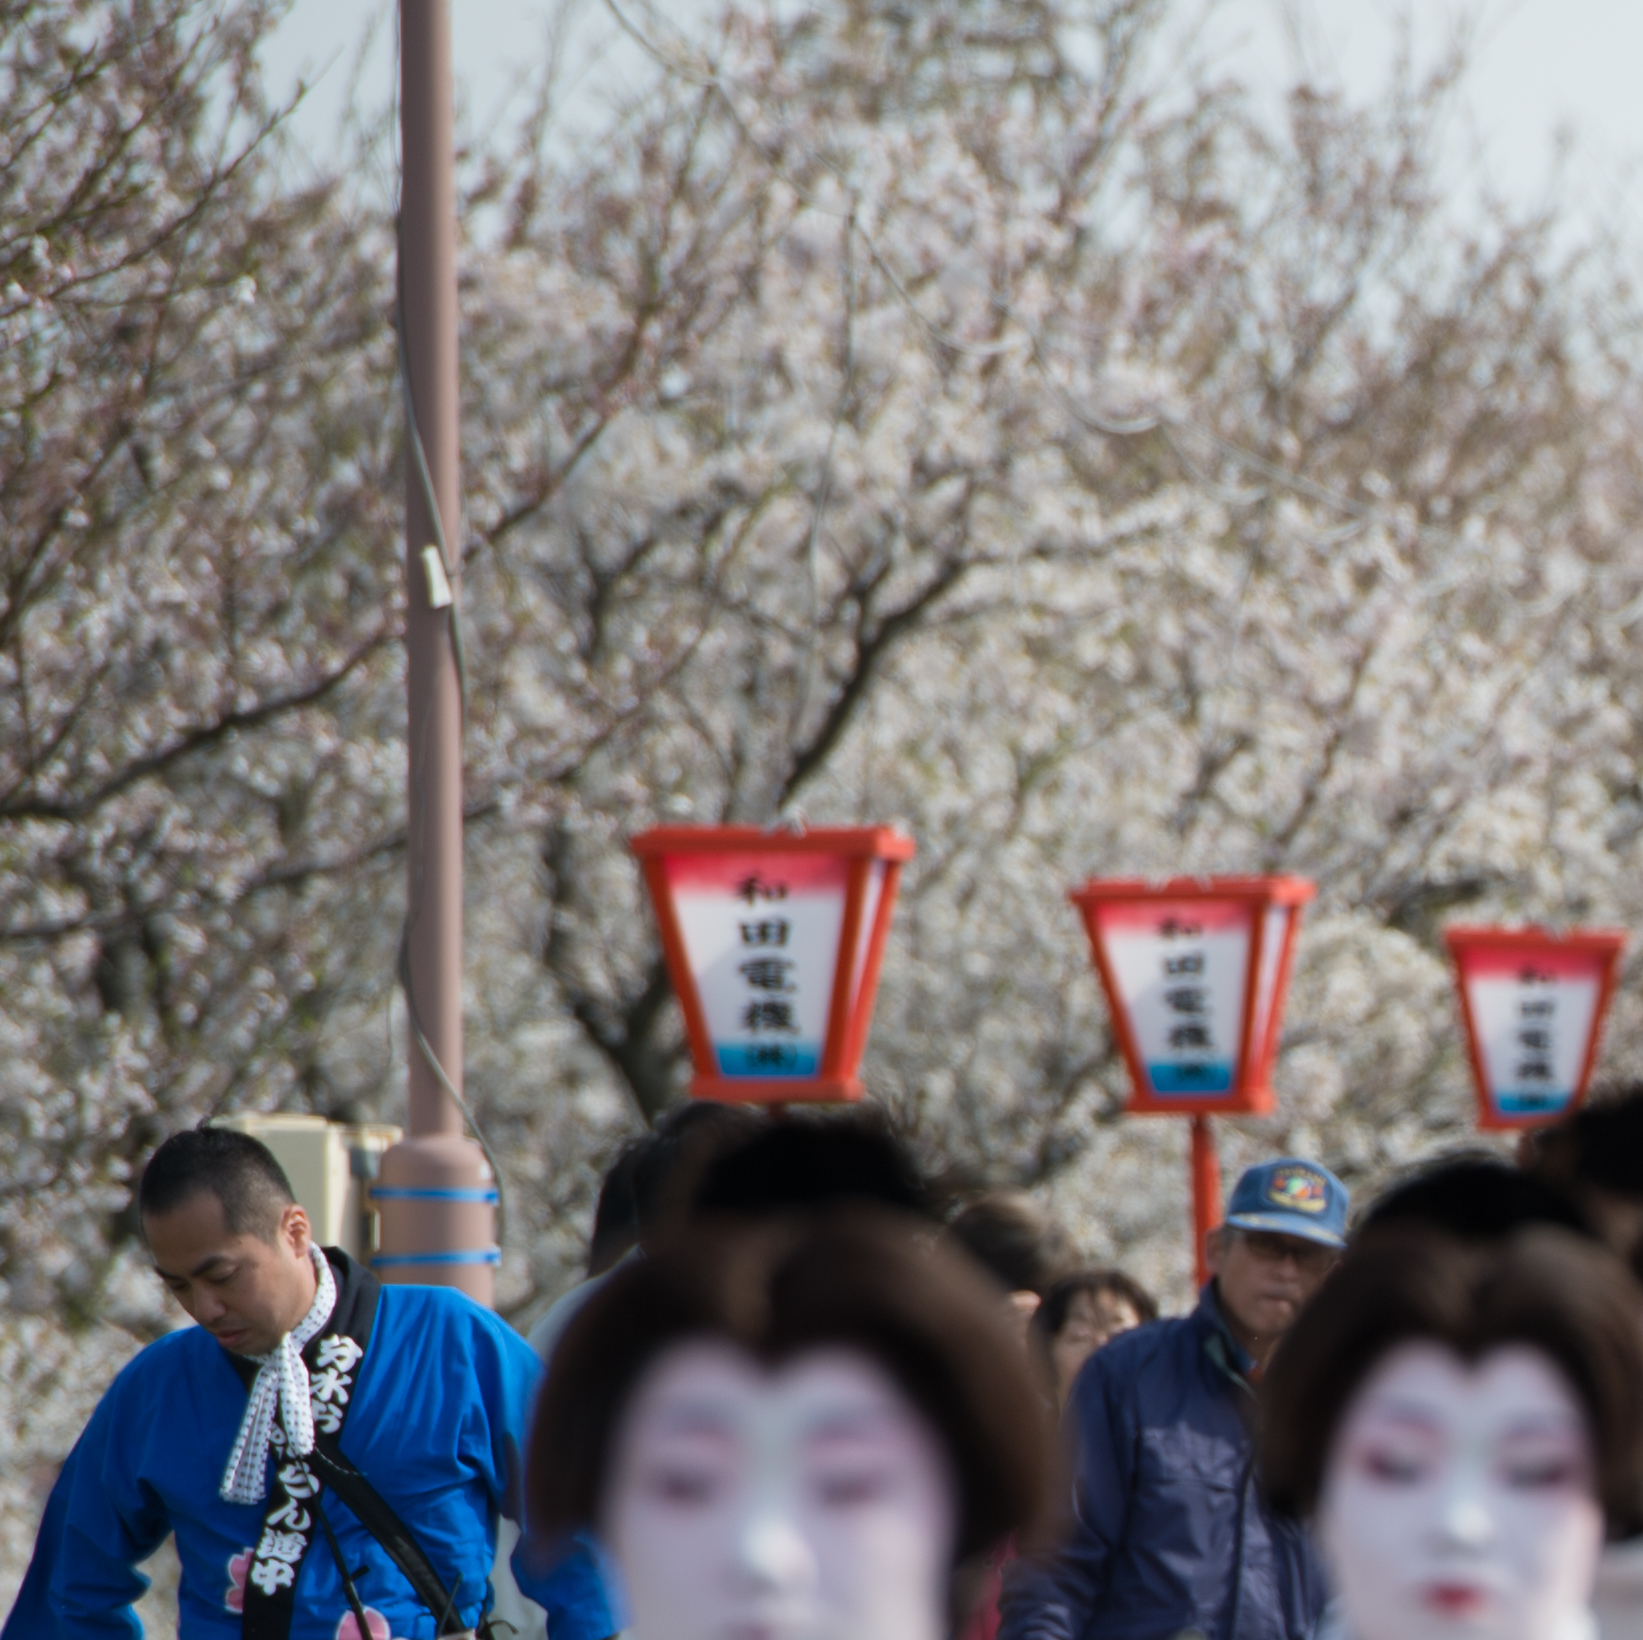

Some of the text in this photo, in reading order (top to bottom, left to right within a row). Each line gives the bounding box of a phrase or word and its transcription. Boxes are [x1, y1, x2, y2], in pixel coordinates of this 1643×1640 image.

[251, 1333, 364, 1597] 分水おらん道中
